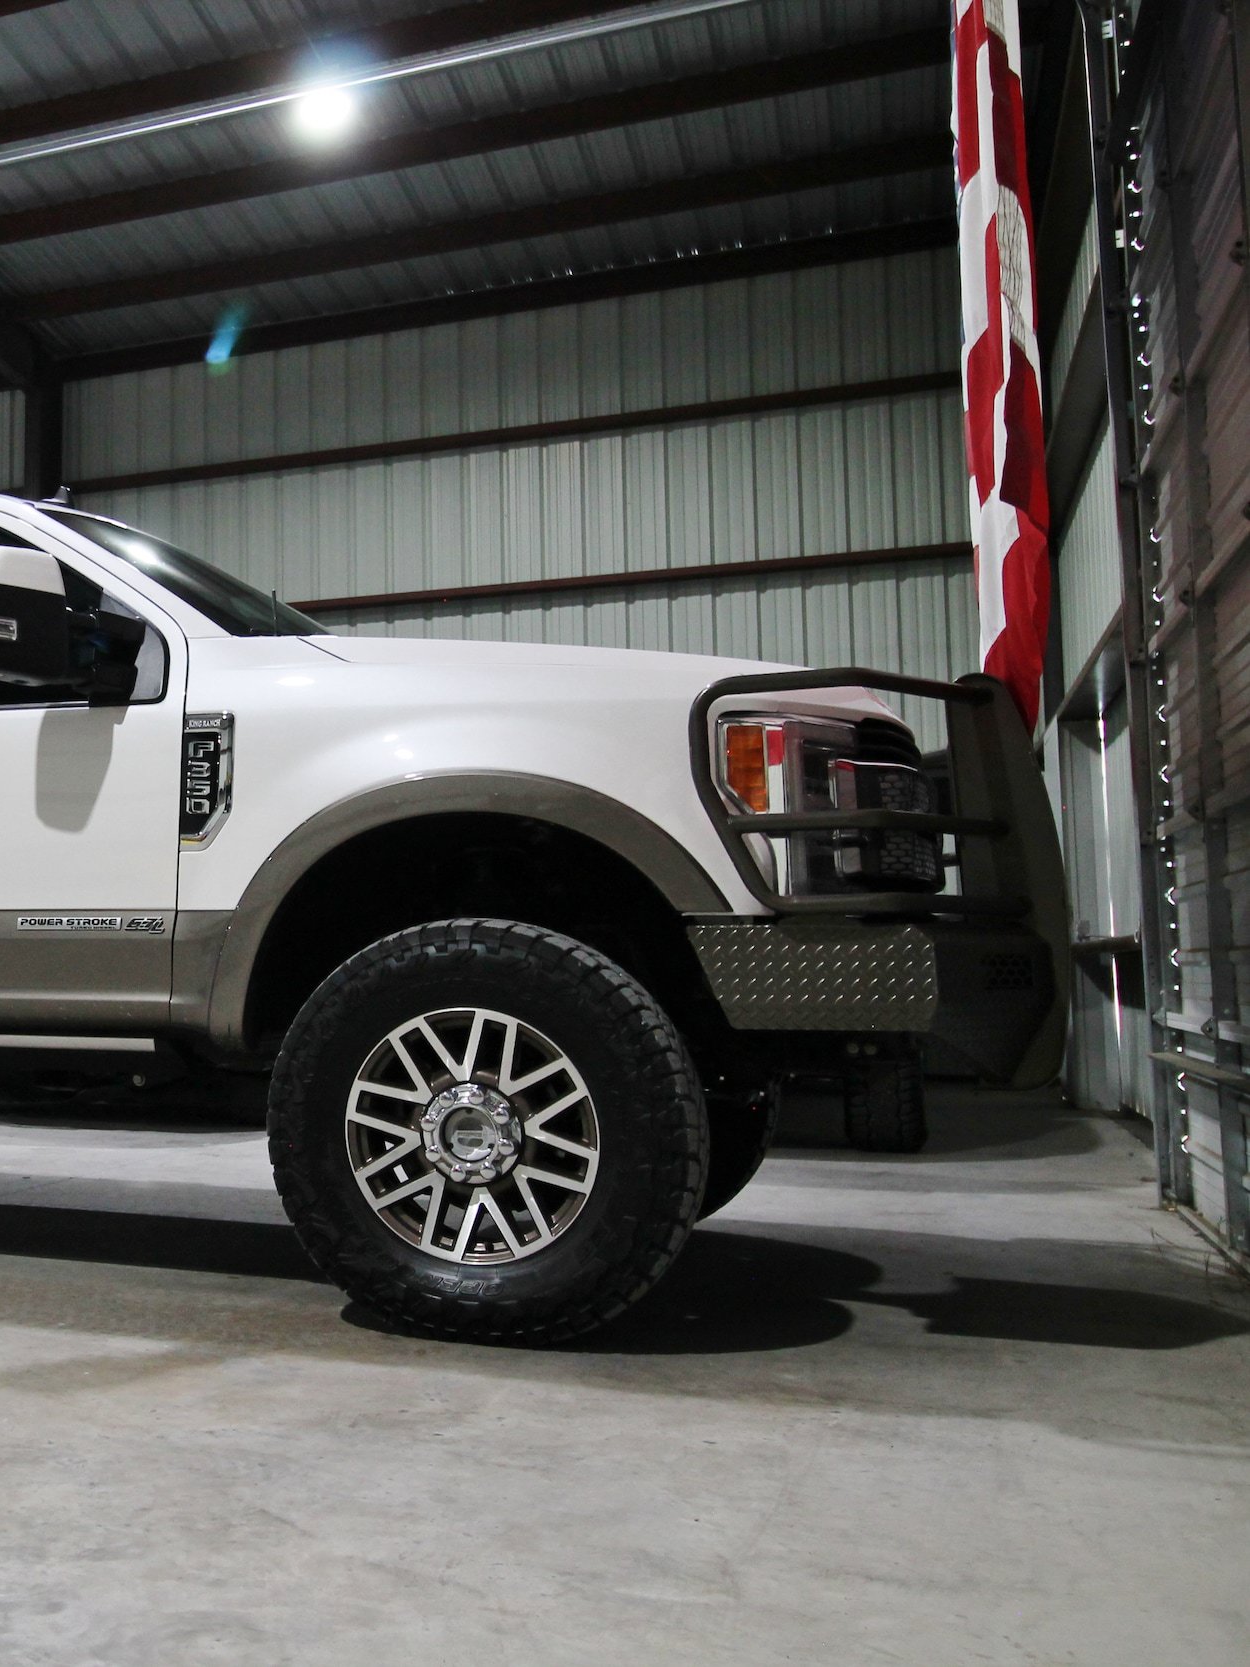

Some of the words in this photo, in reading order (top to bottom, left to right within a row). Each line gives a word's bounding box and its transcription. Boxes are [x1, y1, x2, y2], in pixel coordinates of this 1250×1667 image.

[186, 741, 214, 814] F350
[20, 918, 63, 926] POWER
[66, 918, 117, 926] STROKE
